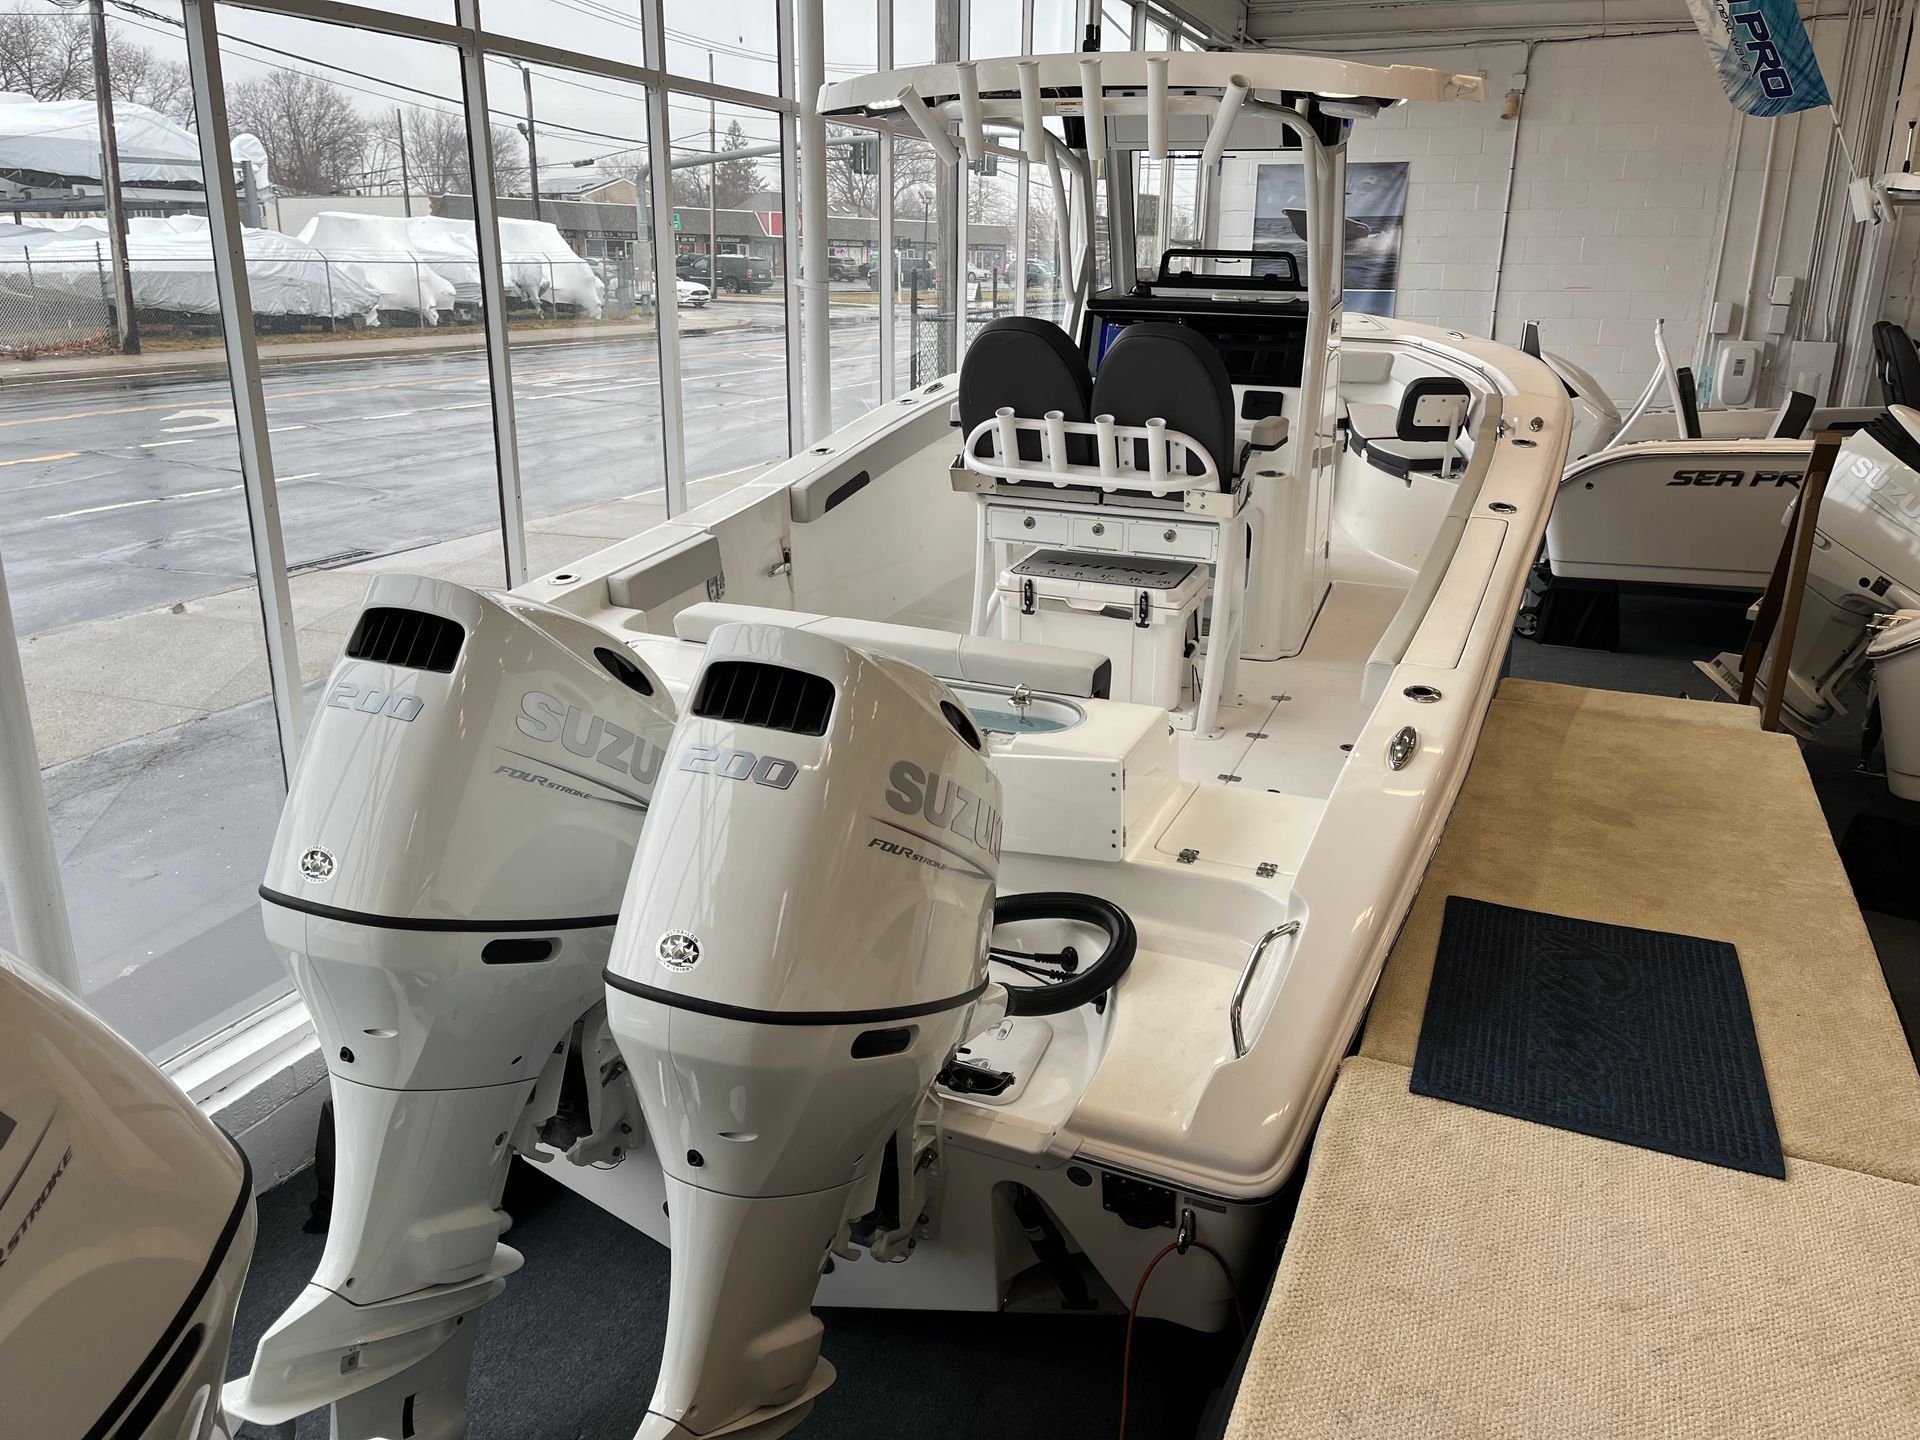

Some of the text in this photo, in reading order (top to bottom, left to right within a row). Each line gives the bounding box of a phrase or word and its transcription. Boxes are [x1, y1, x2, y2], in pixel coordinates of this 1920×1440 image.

[1731, 37, 1751, 72] wave
[1733, 10, 1794, 99] PRO
[1666, 470, 1745, 487] SEA
[327, 682, 425, 722] 200
[679, 746, 799, 790] 200
